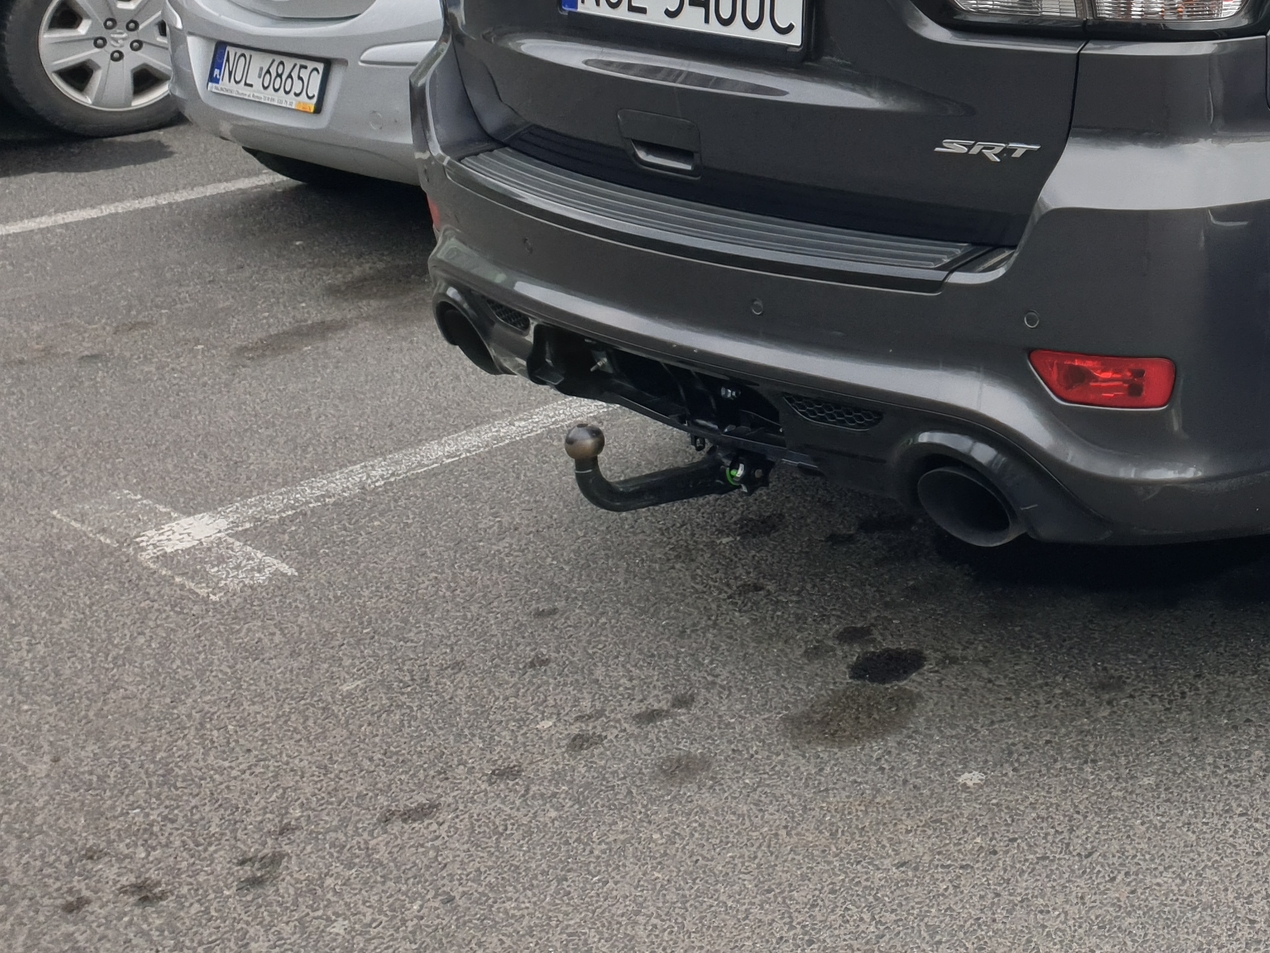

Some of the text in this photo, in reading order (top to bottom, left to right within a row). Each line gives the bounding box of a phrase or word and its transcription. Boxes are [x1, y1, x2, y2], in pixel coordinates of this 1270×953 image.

[221, 50, 254, 88] NOL
[261, 58, 320, 100] 6865C
[934, 138, 1042, 163] SRT
